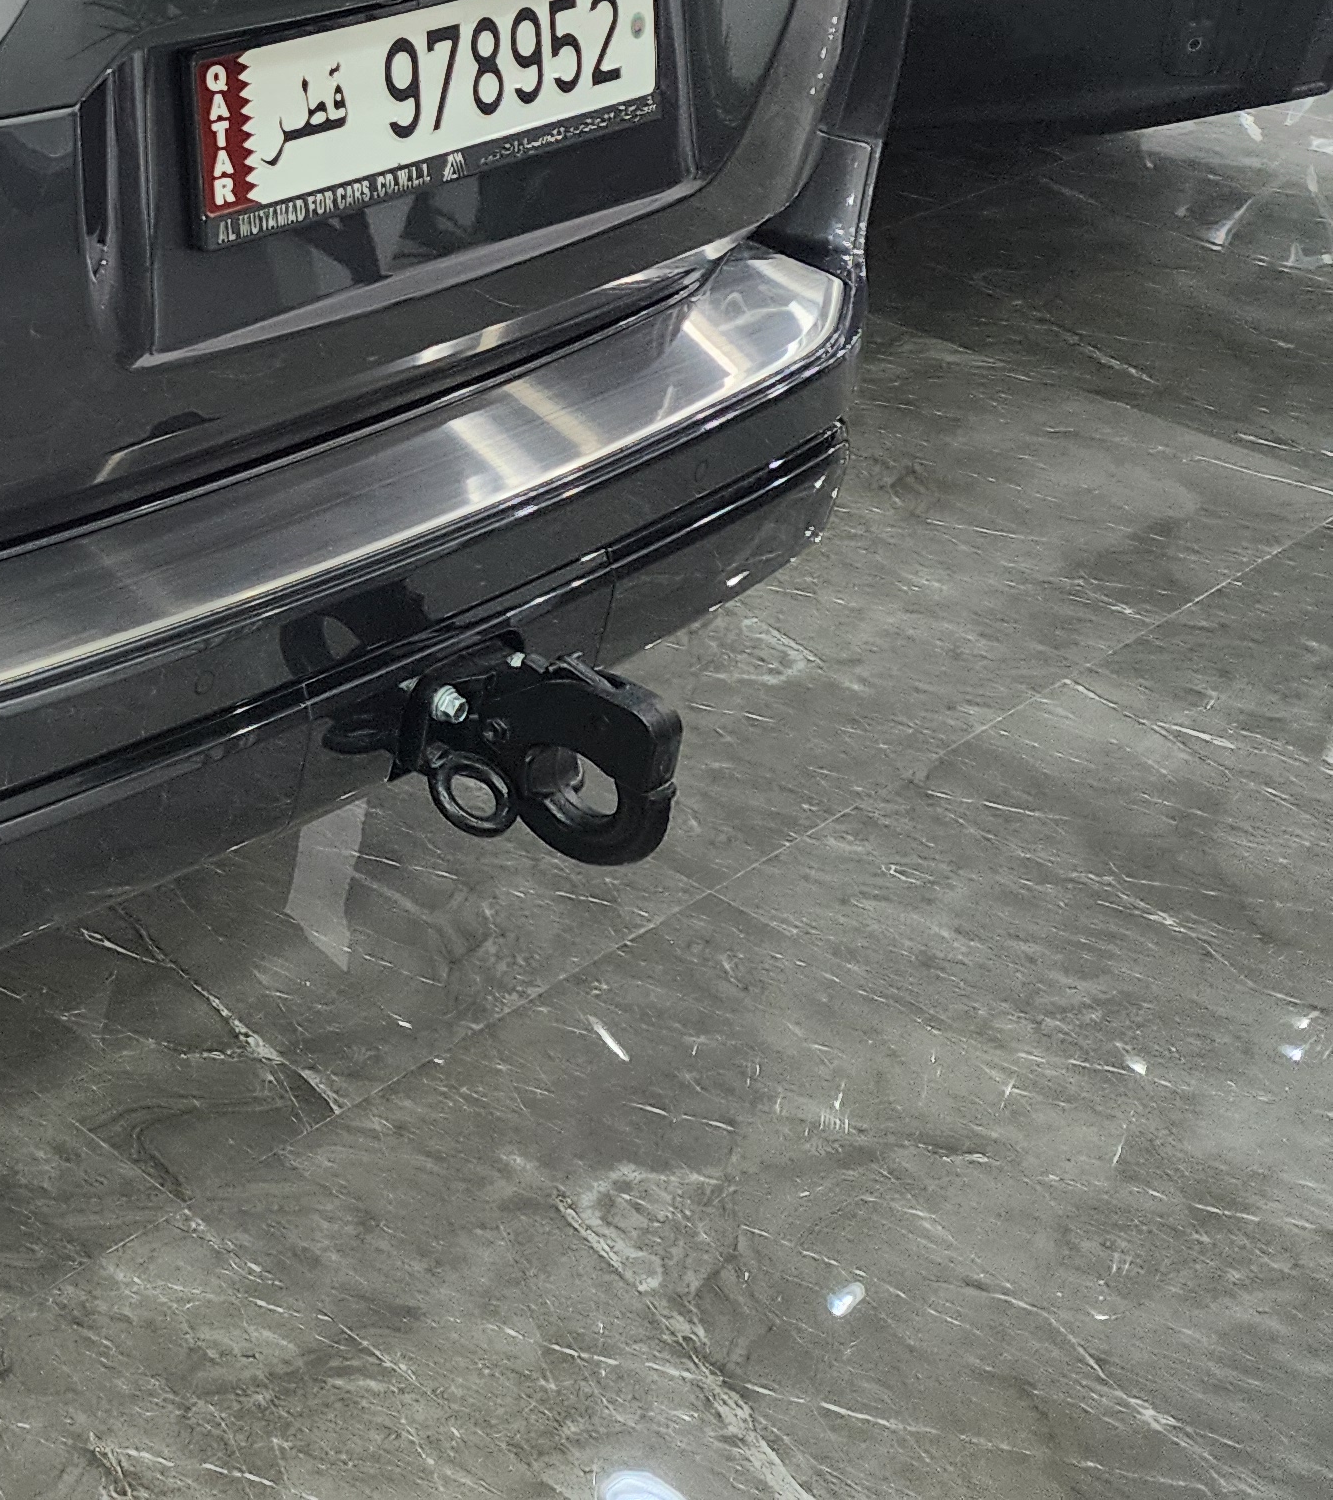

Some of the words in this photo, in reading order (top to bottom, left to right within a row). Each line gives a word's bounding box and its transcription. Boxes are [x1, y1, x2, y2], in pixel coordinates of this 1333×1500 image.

[205, 64, 236, 206] QATAR
[260, 61, 349, 167] قطر
[217, 218, 237, 245] AL
[238, 203, 306, 238] MUTAMAD
[308, 190, 334, 219] FOR
[337, 180, 372, 210] CARS
